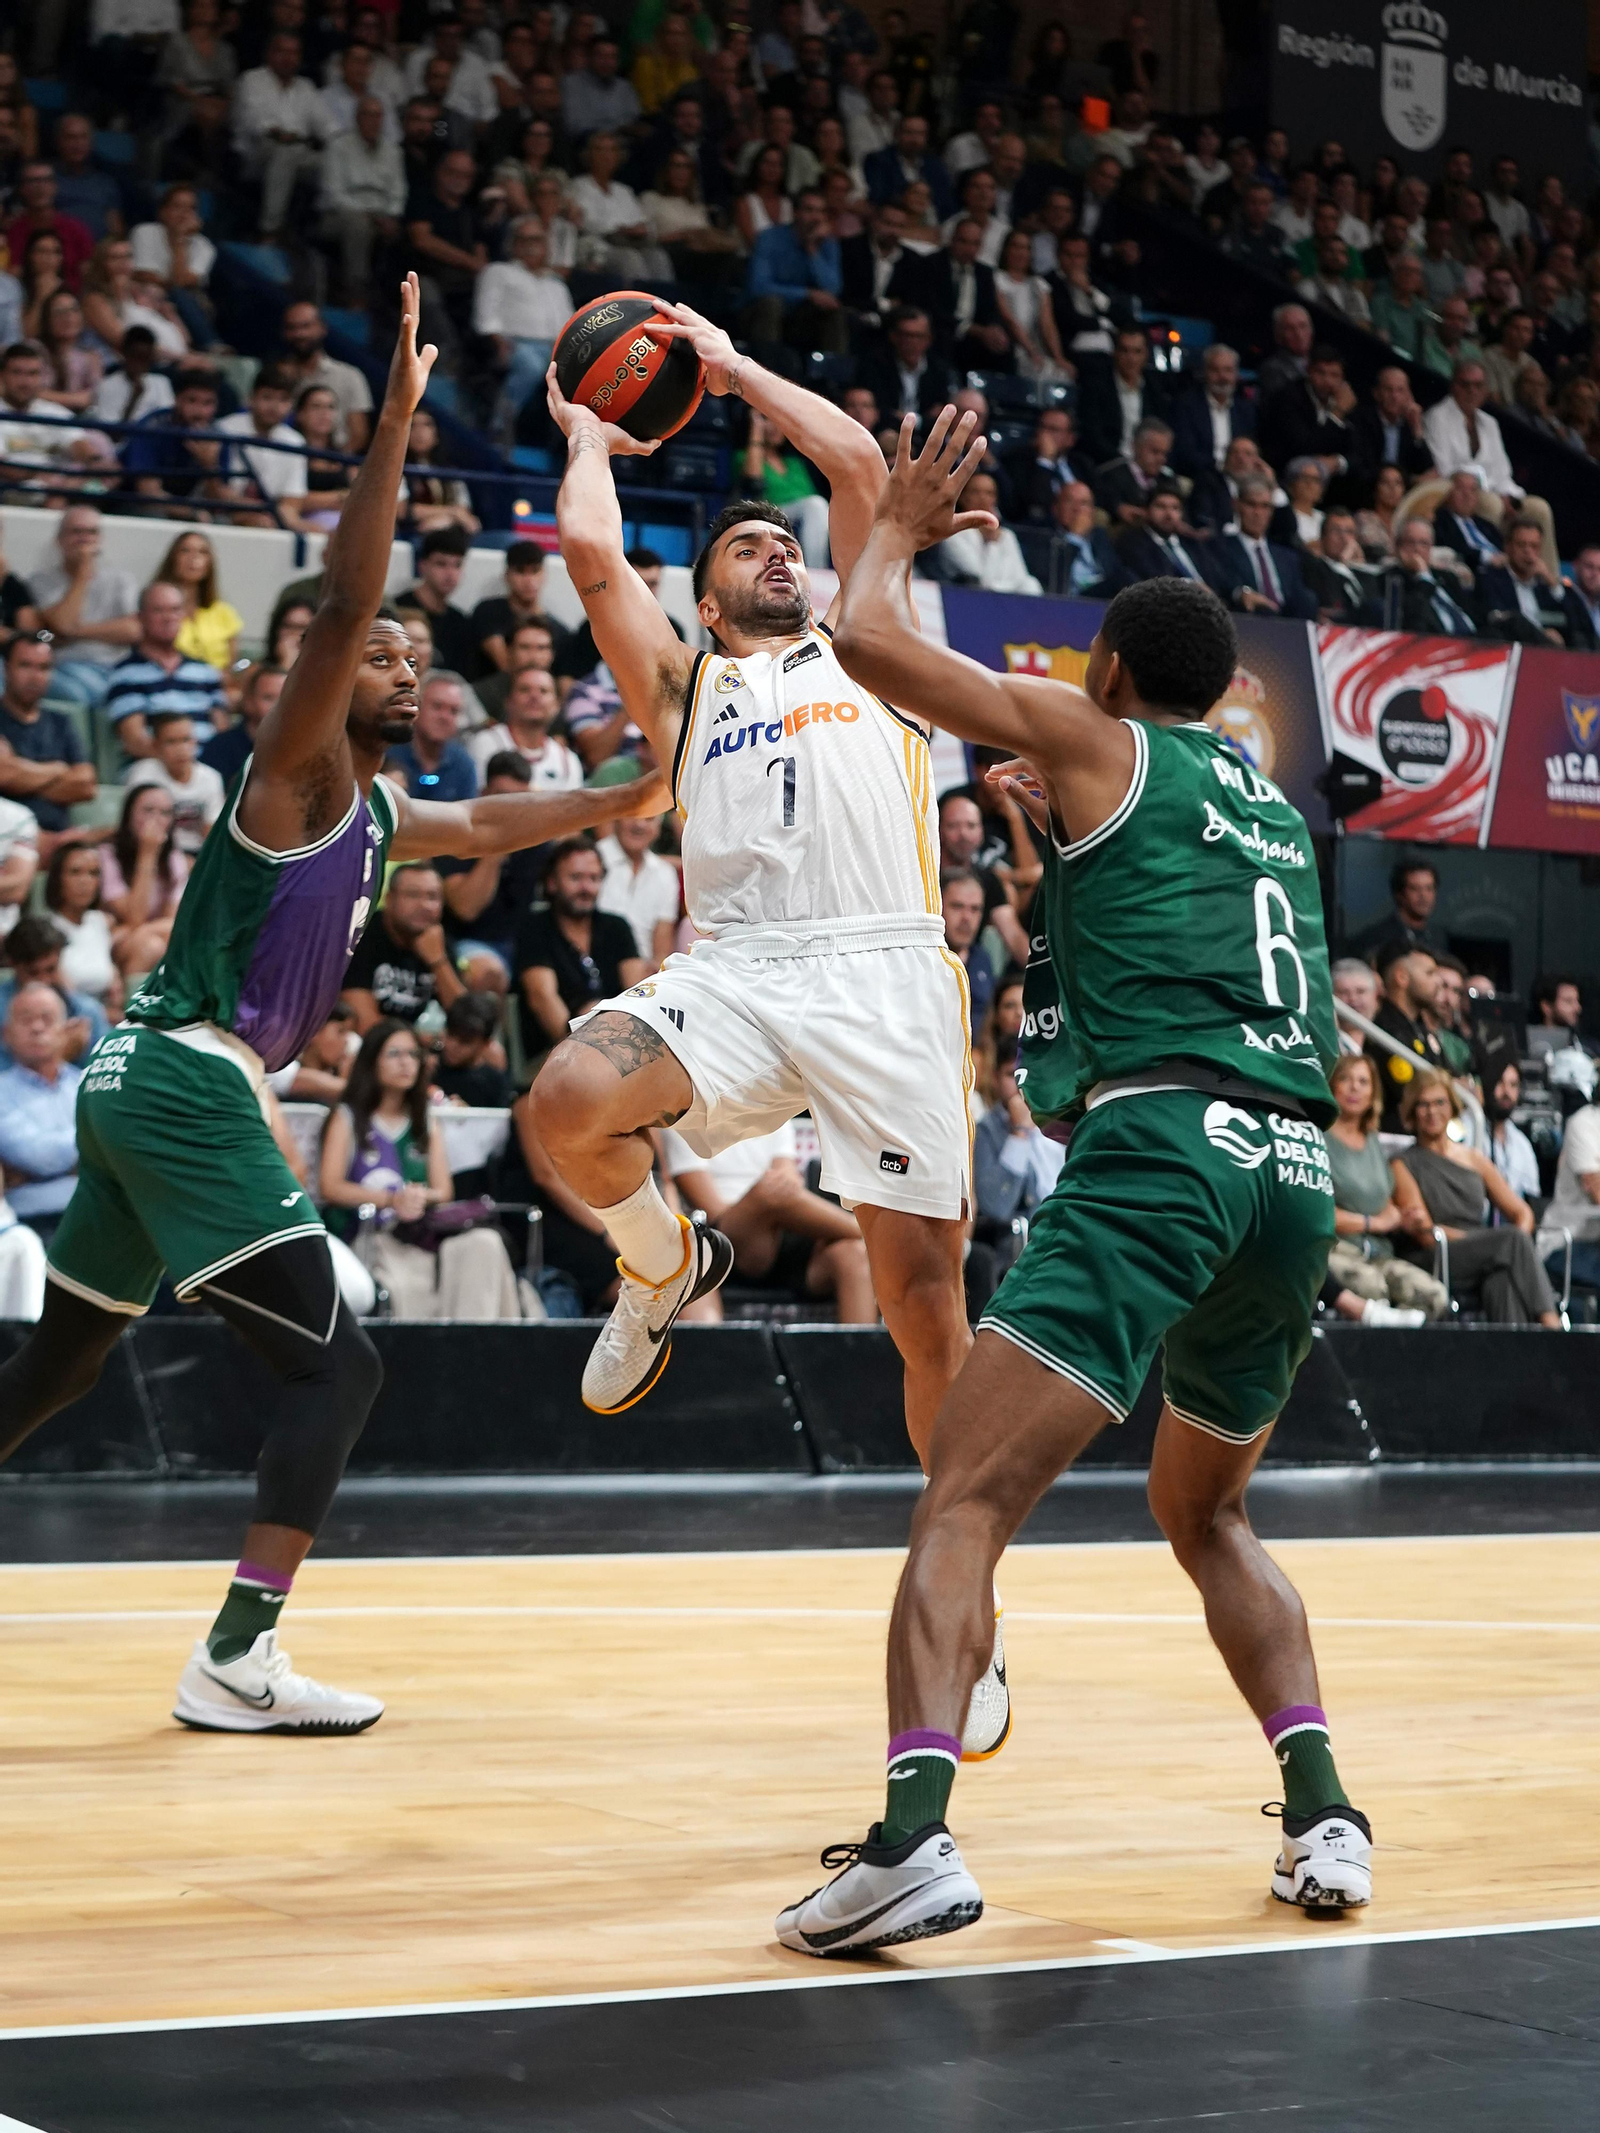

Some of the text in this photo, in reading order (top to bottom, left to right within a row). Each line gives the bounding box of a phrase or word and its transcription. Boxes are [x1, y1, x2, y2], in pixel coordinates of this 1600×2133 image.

[1278, 24, 1583, 107] Región de Murcia
[589, 335, 659, 411] liga ende
[1545, 751, 1600, 784] UCA
[1253, 876, 1309, 1017] 6
[881, 1159, 902, 1172] acb
[1273, 1138, 1331, 1175] DEL SO
